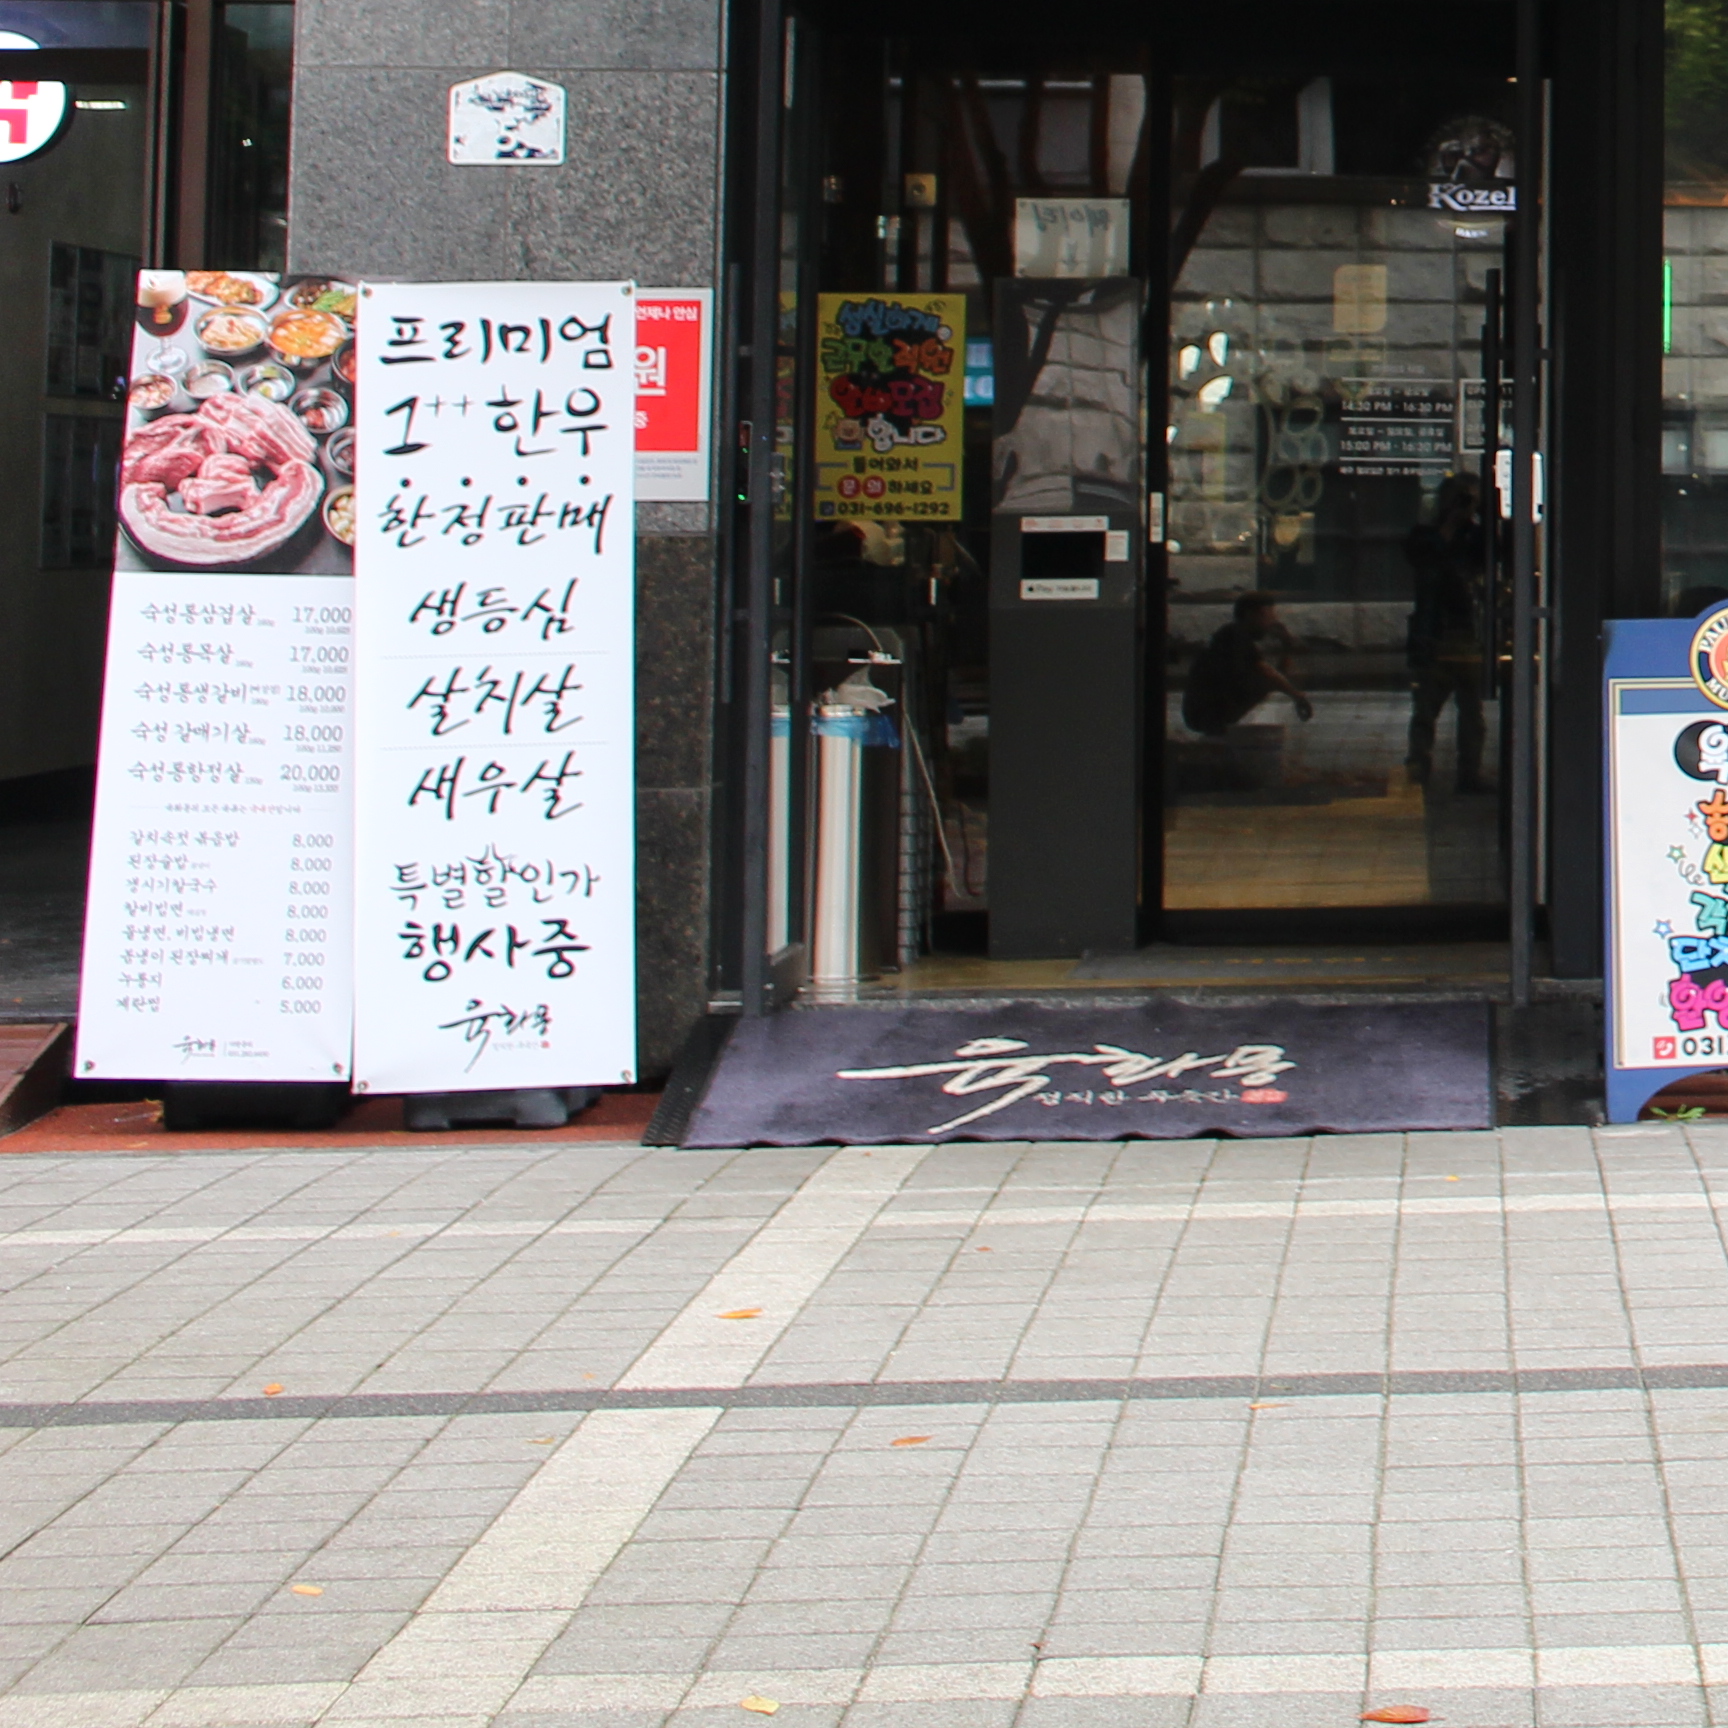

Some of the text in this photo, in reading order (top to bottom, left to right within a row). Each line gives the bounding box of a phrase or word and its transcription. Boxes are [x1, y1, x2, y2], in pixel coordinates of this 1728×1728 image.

[1427, 182, 1517, 211] Kozel
[378, 311, 615, 370] 프리미엄
[484, 383, 610, 458] 한우
[377, 491, 615, 556] 한정판매
[837, 501, 950, 516] 031-696-1292
[409, 576, 580, 642] 생등심
[406, 662, 585, 736] 살치살
[407, 749, 585, 821] 새우살
[388, 841, 602, 911] 특별할인가
[397, 918, 593, 982] 행사중
[835, 1035, 1298, 1135] 육화몽
